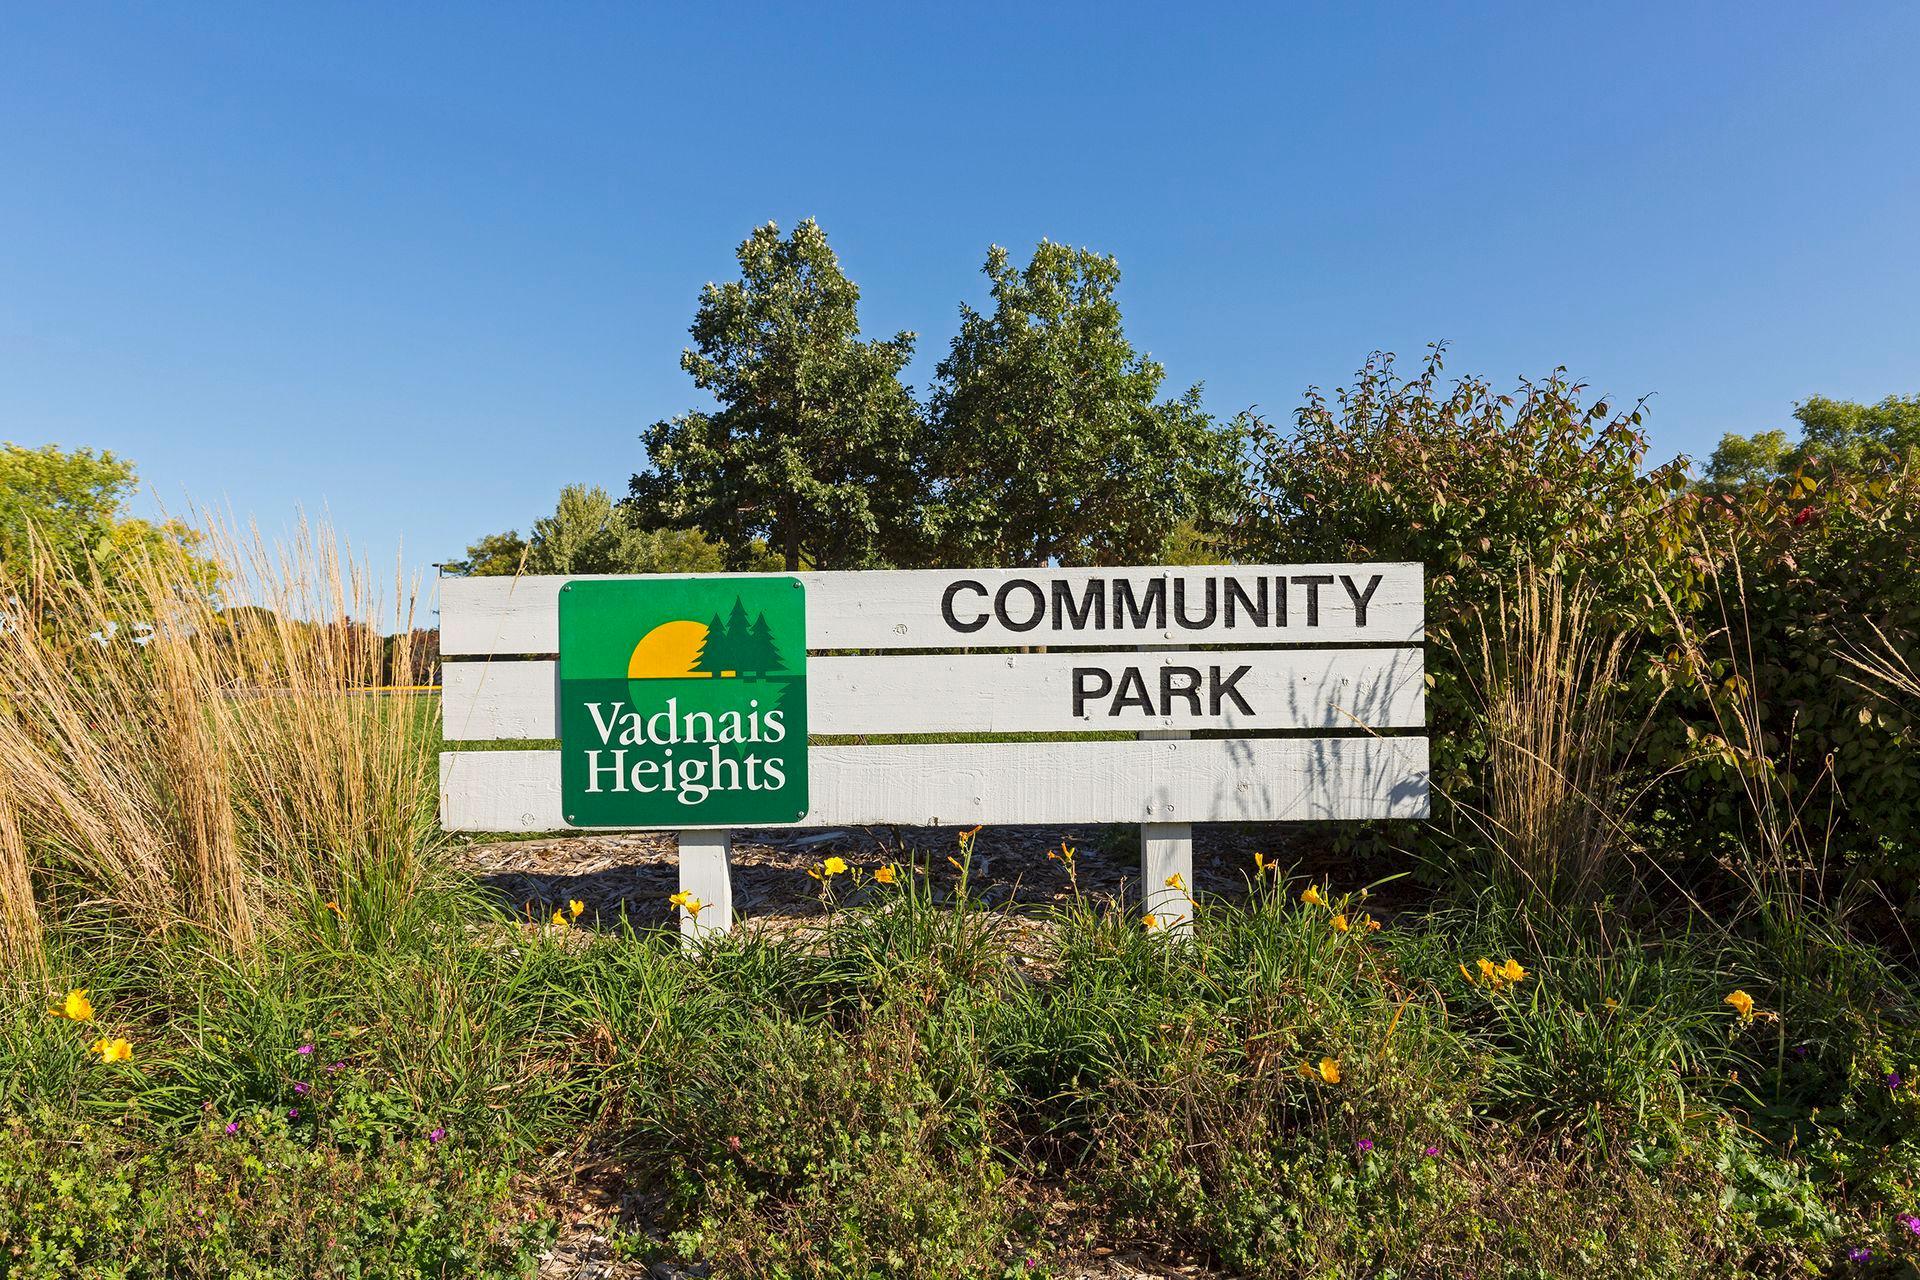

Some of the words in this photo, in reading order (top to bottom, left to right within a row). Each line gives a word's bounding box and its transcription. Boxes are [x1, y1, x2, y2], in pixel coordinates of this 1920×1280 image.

[942, 574, 1384, 633] COMMUNITY
[1072, 665, 1257, 717] PARK
[584, 697, 786, 746] Vadnais
[584, 743, 787, 805] Heights
